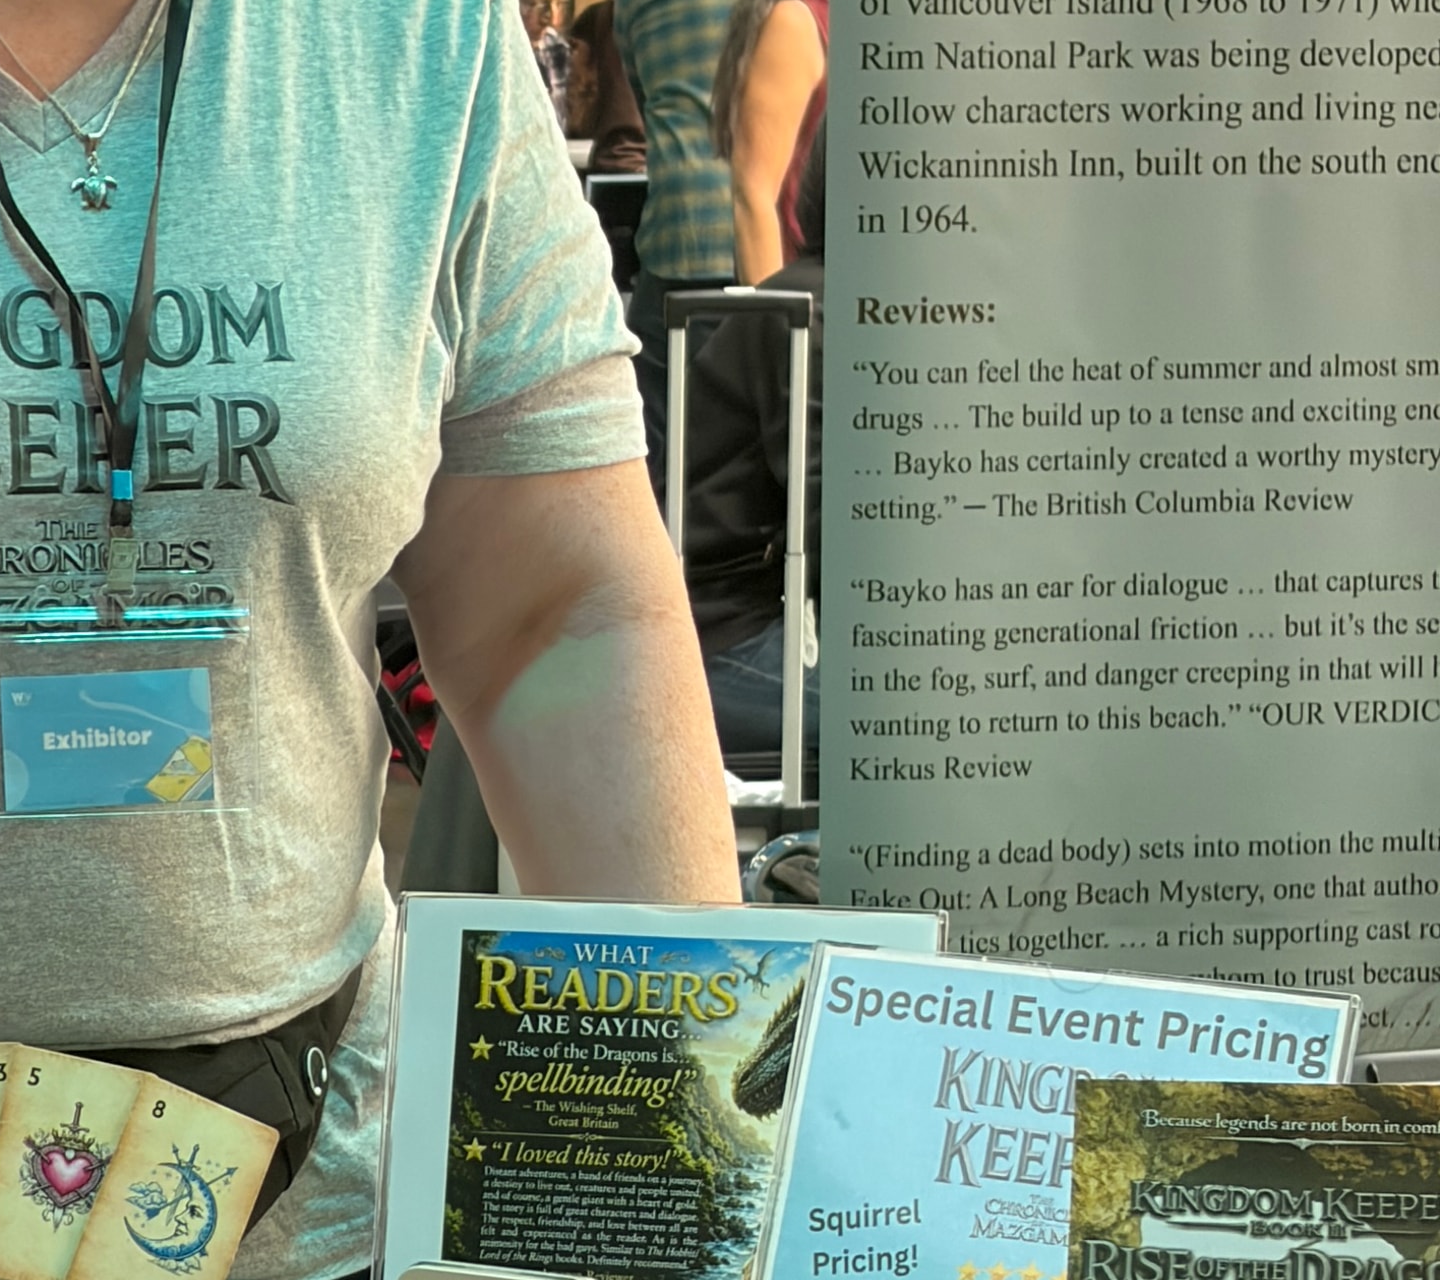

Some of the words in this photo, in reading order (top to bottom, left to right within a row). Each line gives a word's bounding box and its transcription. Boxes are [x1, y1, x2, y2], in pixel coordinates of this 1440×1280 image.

[857, 297, 996, 325] Reviews:
[993, 494, 1037, 517] The
[1047, 492, 1126, 516] British
[1136, 489, 1254, 515] Columbia
[1265, 488, 1353, 513] Review
[36, 519, 99, 542] THE
[43, 726, 152, 751] Exhibitor
[850, 757, 935, 781] Kirkus
[945, 755, 1032, 778] Review
[574, 943, 653, 964] WHAT
[475, 954, 738, 1022] READERS
[517, 1014, 570, 1035] ARE
[826, 975, 994, 1030] Special
[1008, 995, 1143, 1047] Event
[1156, 1010, 1330, 1079] Pricing
[543, 1043, 560, 1058] of
[564, 1044, 588, 1060] the
[594, 1043, 657, 1064] Dragons
[27, 1068, 41, 1085] 5
[152, 1100, 166, 1118] 8
[1142, 1109, 1212, 1129] Because
[1216, 1112, 1279, 1133] legends
[1282, 1119, 1307, 1131] are
[1311, 1117, 1338, 1133] not
[1342, 1117, 1382, 1134] born
[1384, 1120, 1400, 1134] in
[516, 1142, 568, 1164] loved
[575, 1145, 609, 1166] this
[1131, 1180, 1317, 1219] KINGDOM
[809, 1199, 921, 1236] Squirrel
[1249, 1221, 1319, 1238] BOOK
[813, 1245, 918, 1276] Pricing!
[1195, 1257, 1230, 1279] OF
